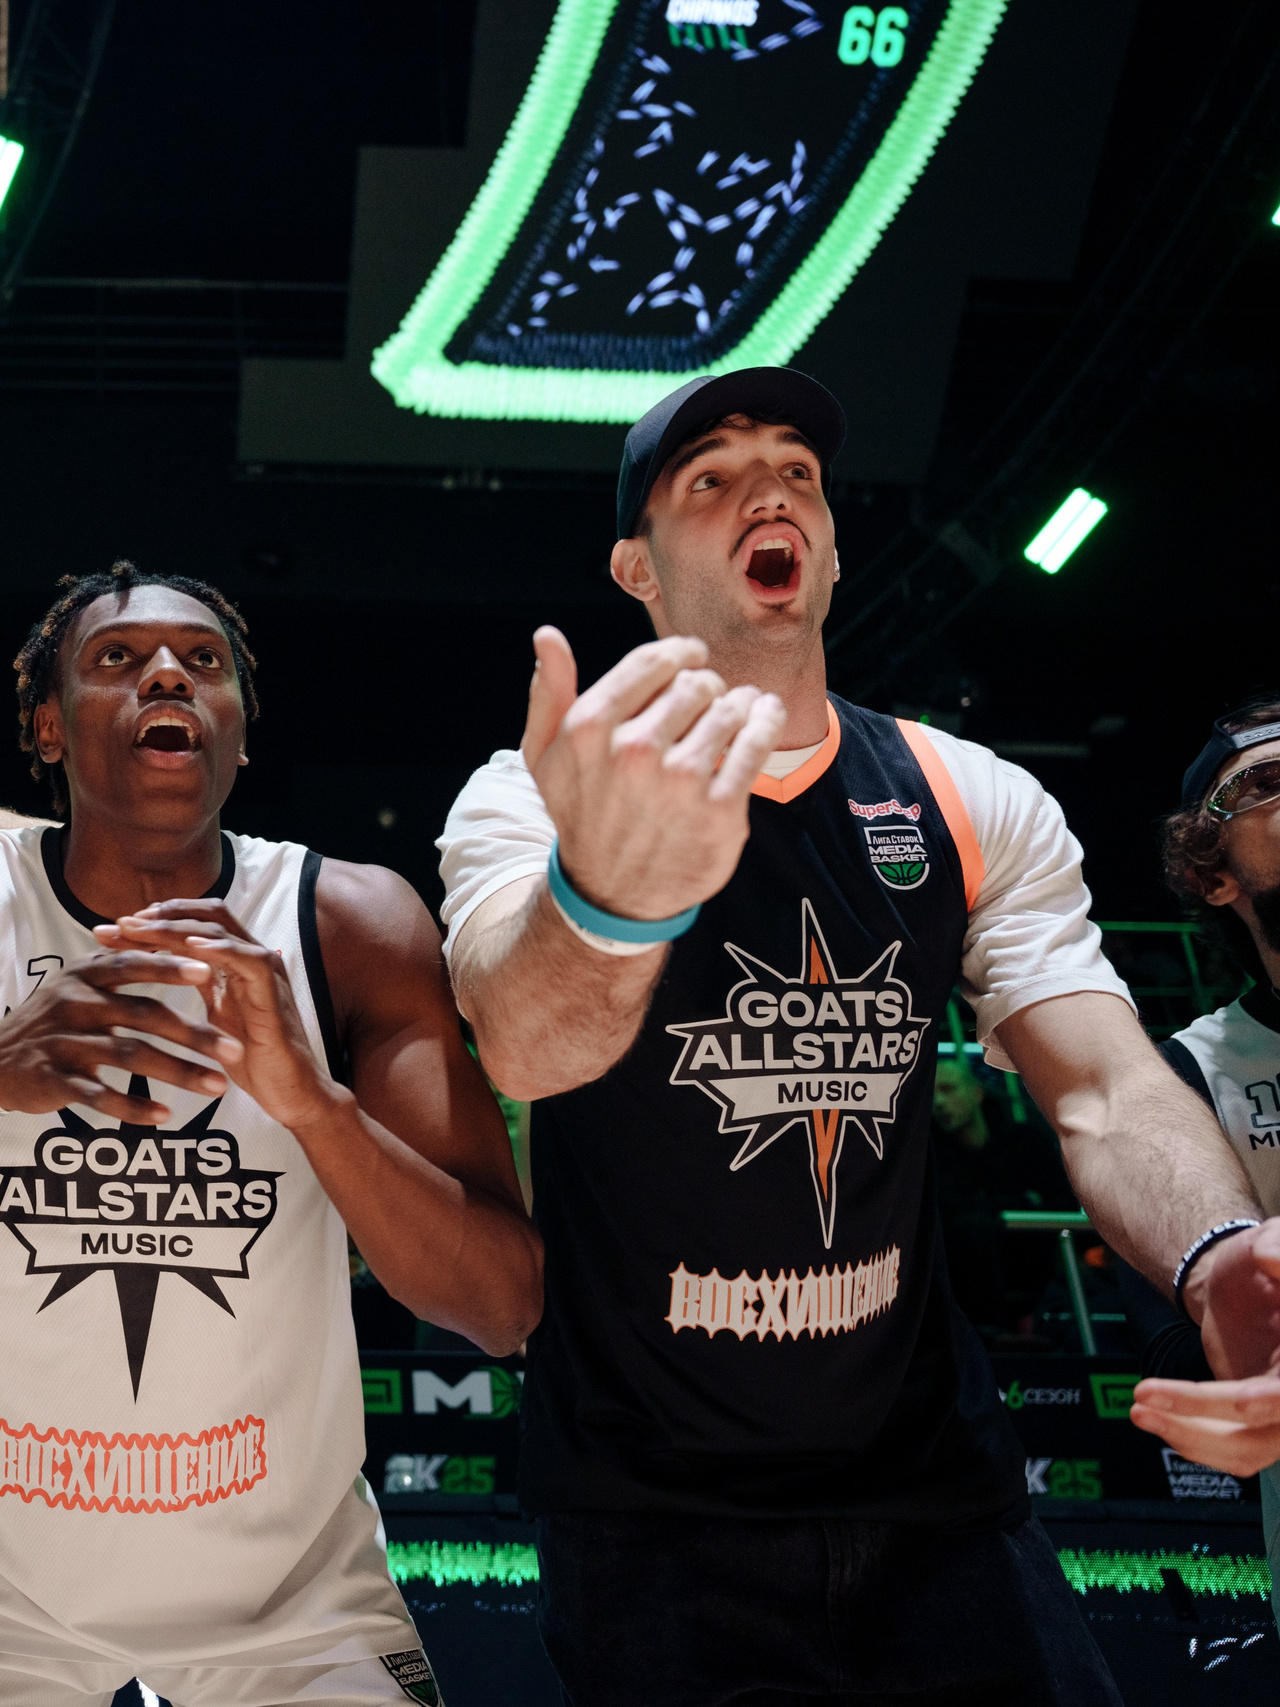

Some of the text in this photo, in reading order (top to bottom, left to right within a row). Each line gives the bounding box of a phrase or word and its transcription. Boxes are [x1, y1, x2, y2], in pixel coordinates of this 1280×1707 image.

[837, 5, 909, 68] 66
[848, 799, 921, 821] SuperSep
[868, 845, 926, 855] MEDIA
[870, 854, 928, 863] BASKET
[738, 990, 904, 1028] GOATS
[688, 1030, 919, 1071] ALLSTARS
[777, 1081, 868, 1104] MUSIC
[42, 1136, 232, 1176] GOATS
[81, 1232, 194, 1258] MUSIC
[391, 1660, 428, 1678] MEDIA
[398, 1671, 431, 1686] BASKE
